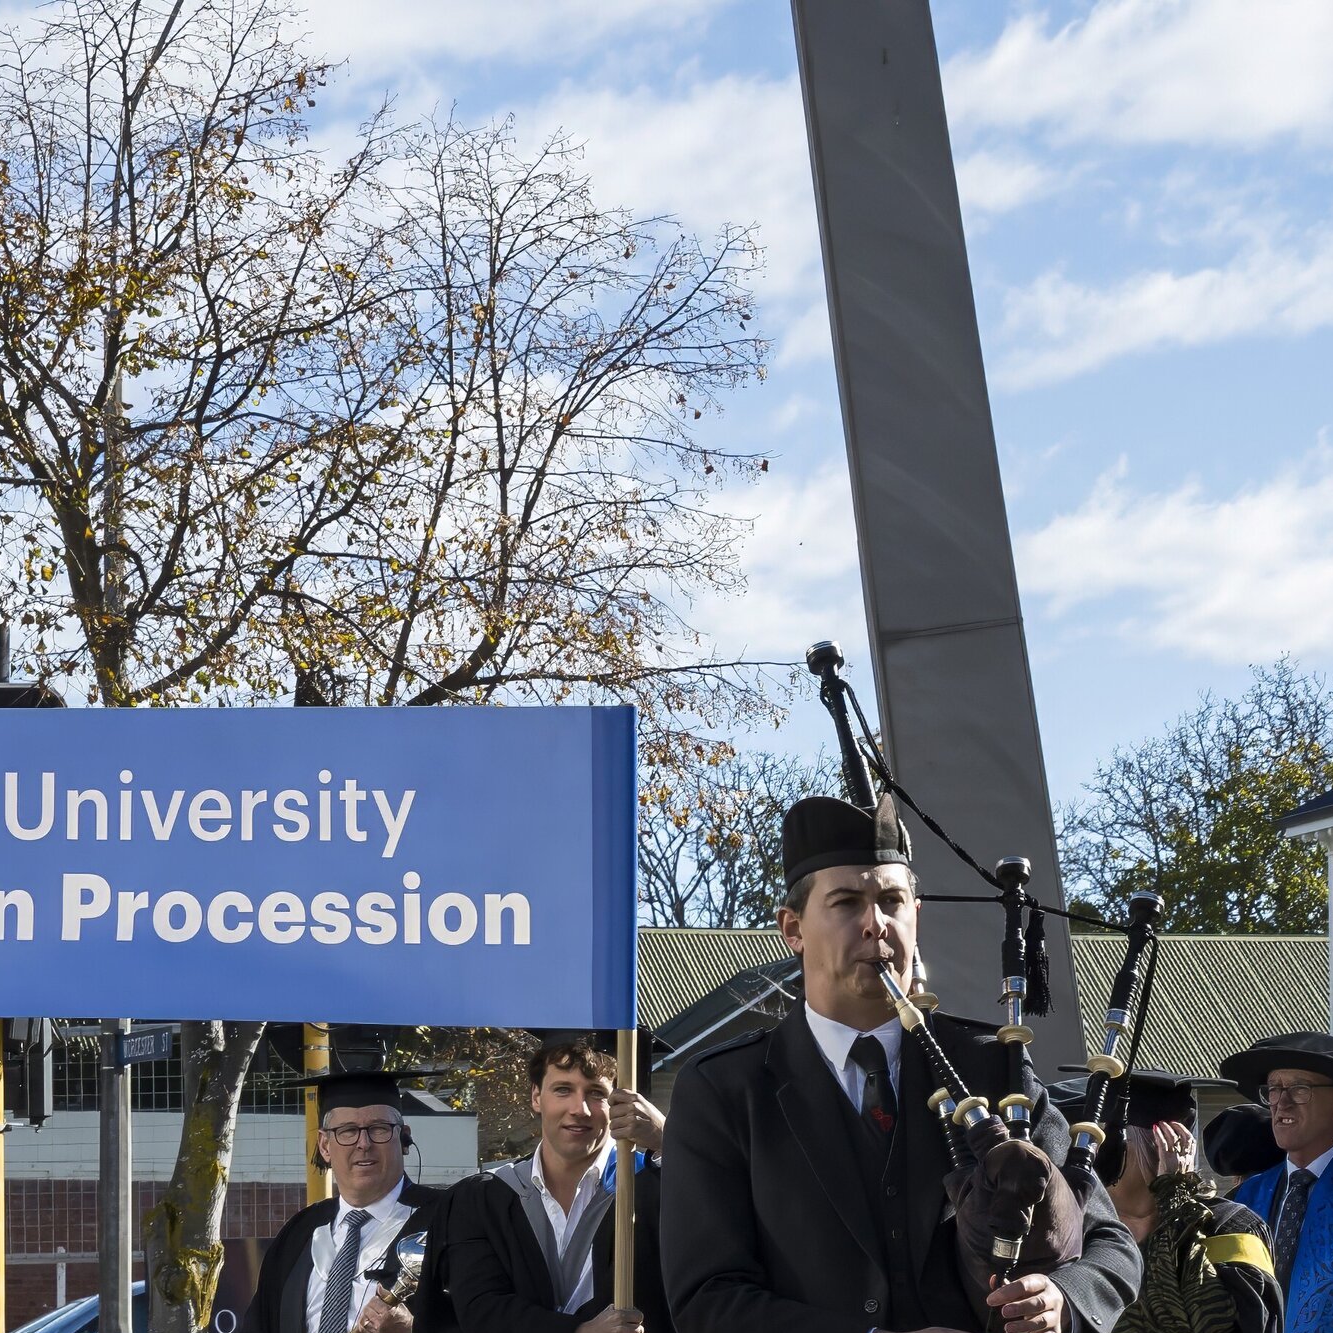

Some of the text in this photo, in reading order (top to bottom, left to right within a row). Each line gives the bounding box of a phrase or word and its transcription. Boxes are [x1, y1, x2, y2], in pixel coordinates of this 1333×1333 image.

[3, 769, 418, 859] University
[60, 871, 533, 947] Procession
[162, 1031, 170, 1053] ST
